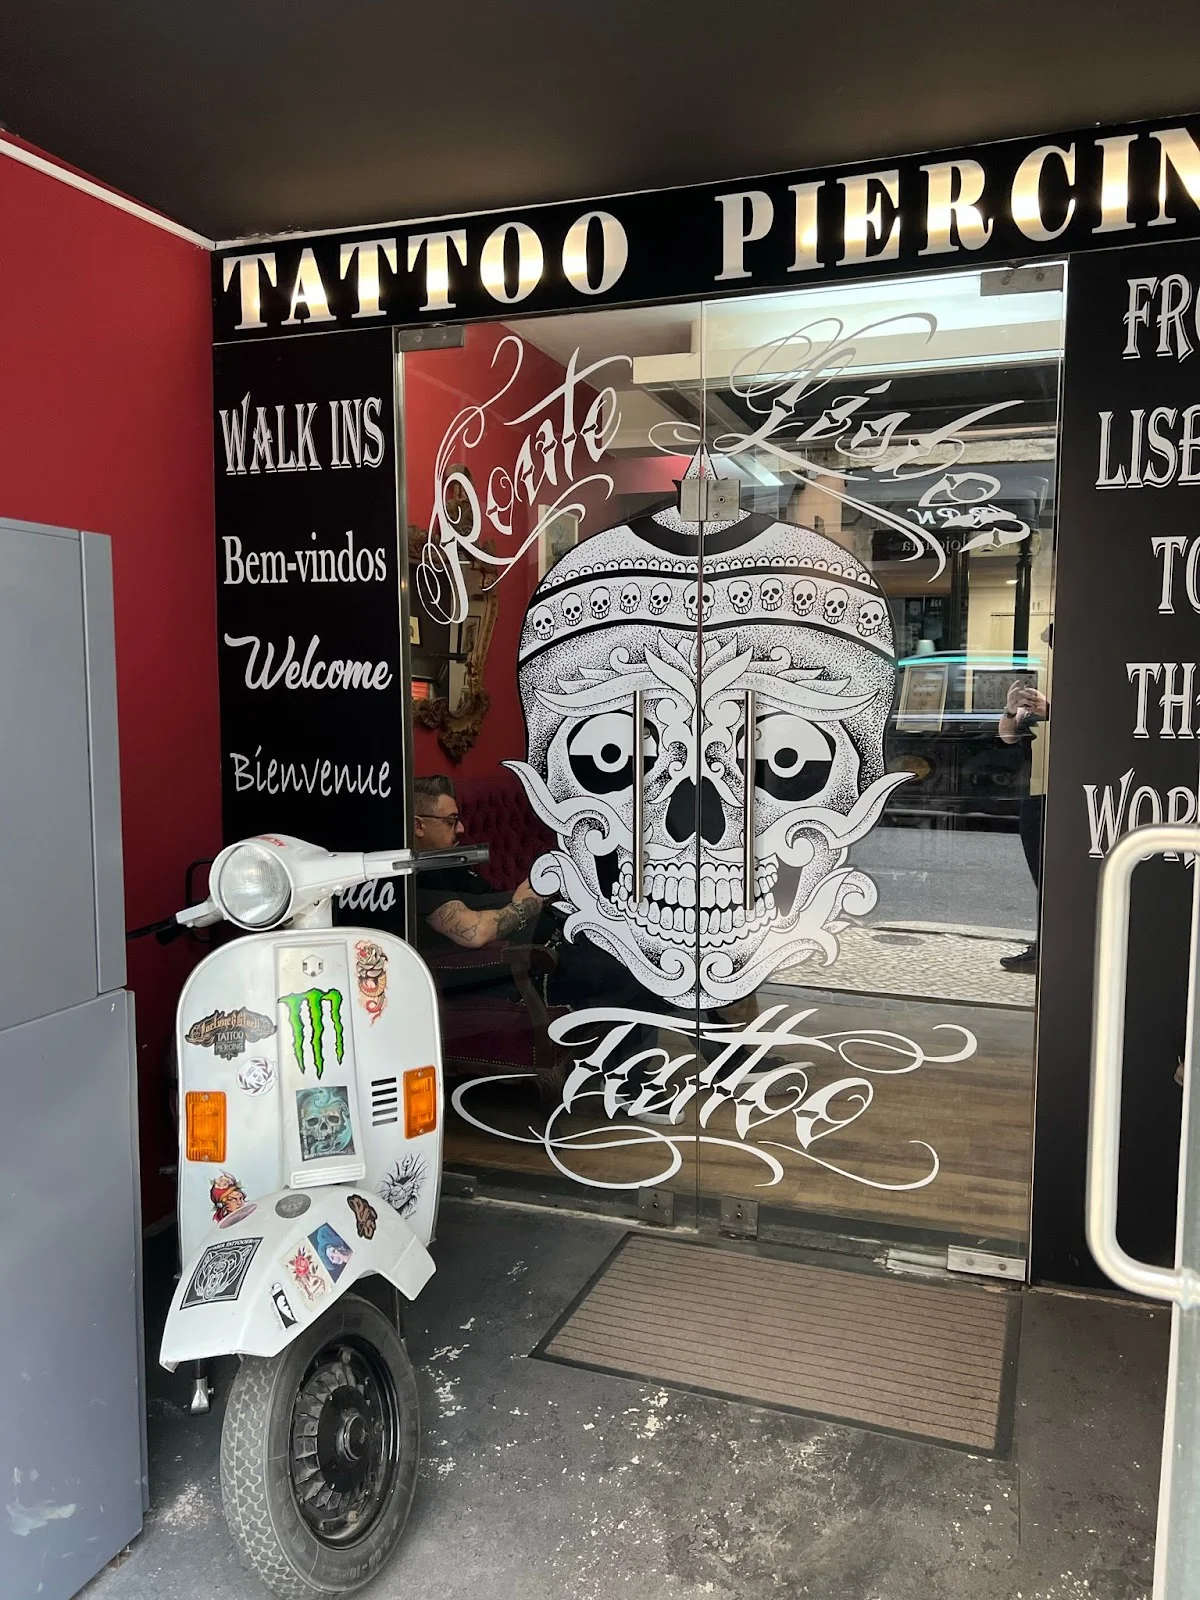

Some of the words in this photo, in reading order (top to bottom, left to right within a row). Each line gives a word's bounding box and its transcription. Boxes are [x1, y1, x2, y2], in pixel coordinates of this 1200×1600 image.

[222, 211, 629, 330] TATTOO
[1122, 274, 1200, 363] FR
[219, 391, 323, 476] WALK
[328, 397, 385, 470] INS
[222, 531, 387, 585] Bem-vindos
[224, 633, 393, 690] Welcome
[1126, 663, 1200, 739] TH
[217, 1031, 243, 1041] TATTOO
[547, 1004, 977, 1150] Tattoo
